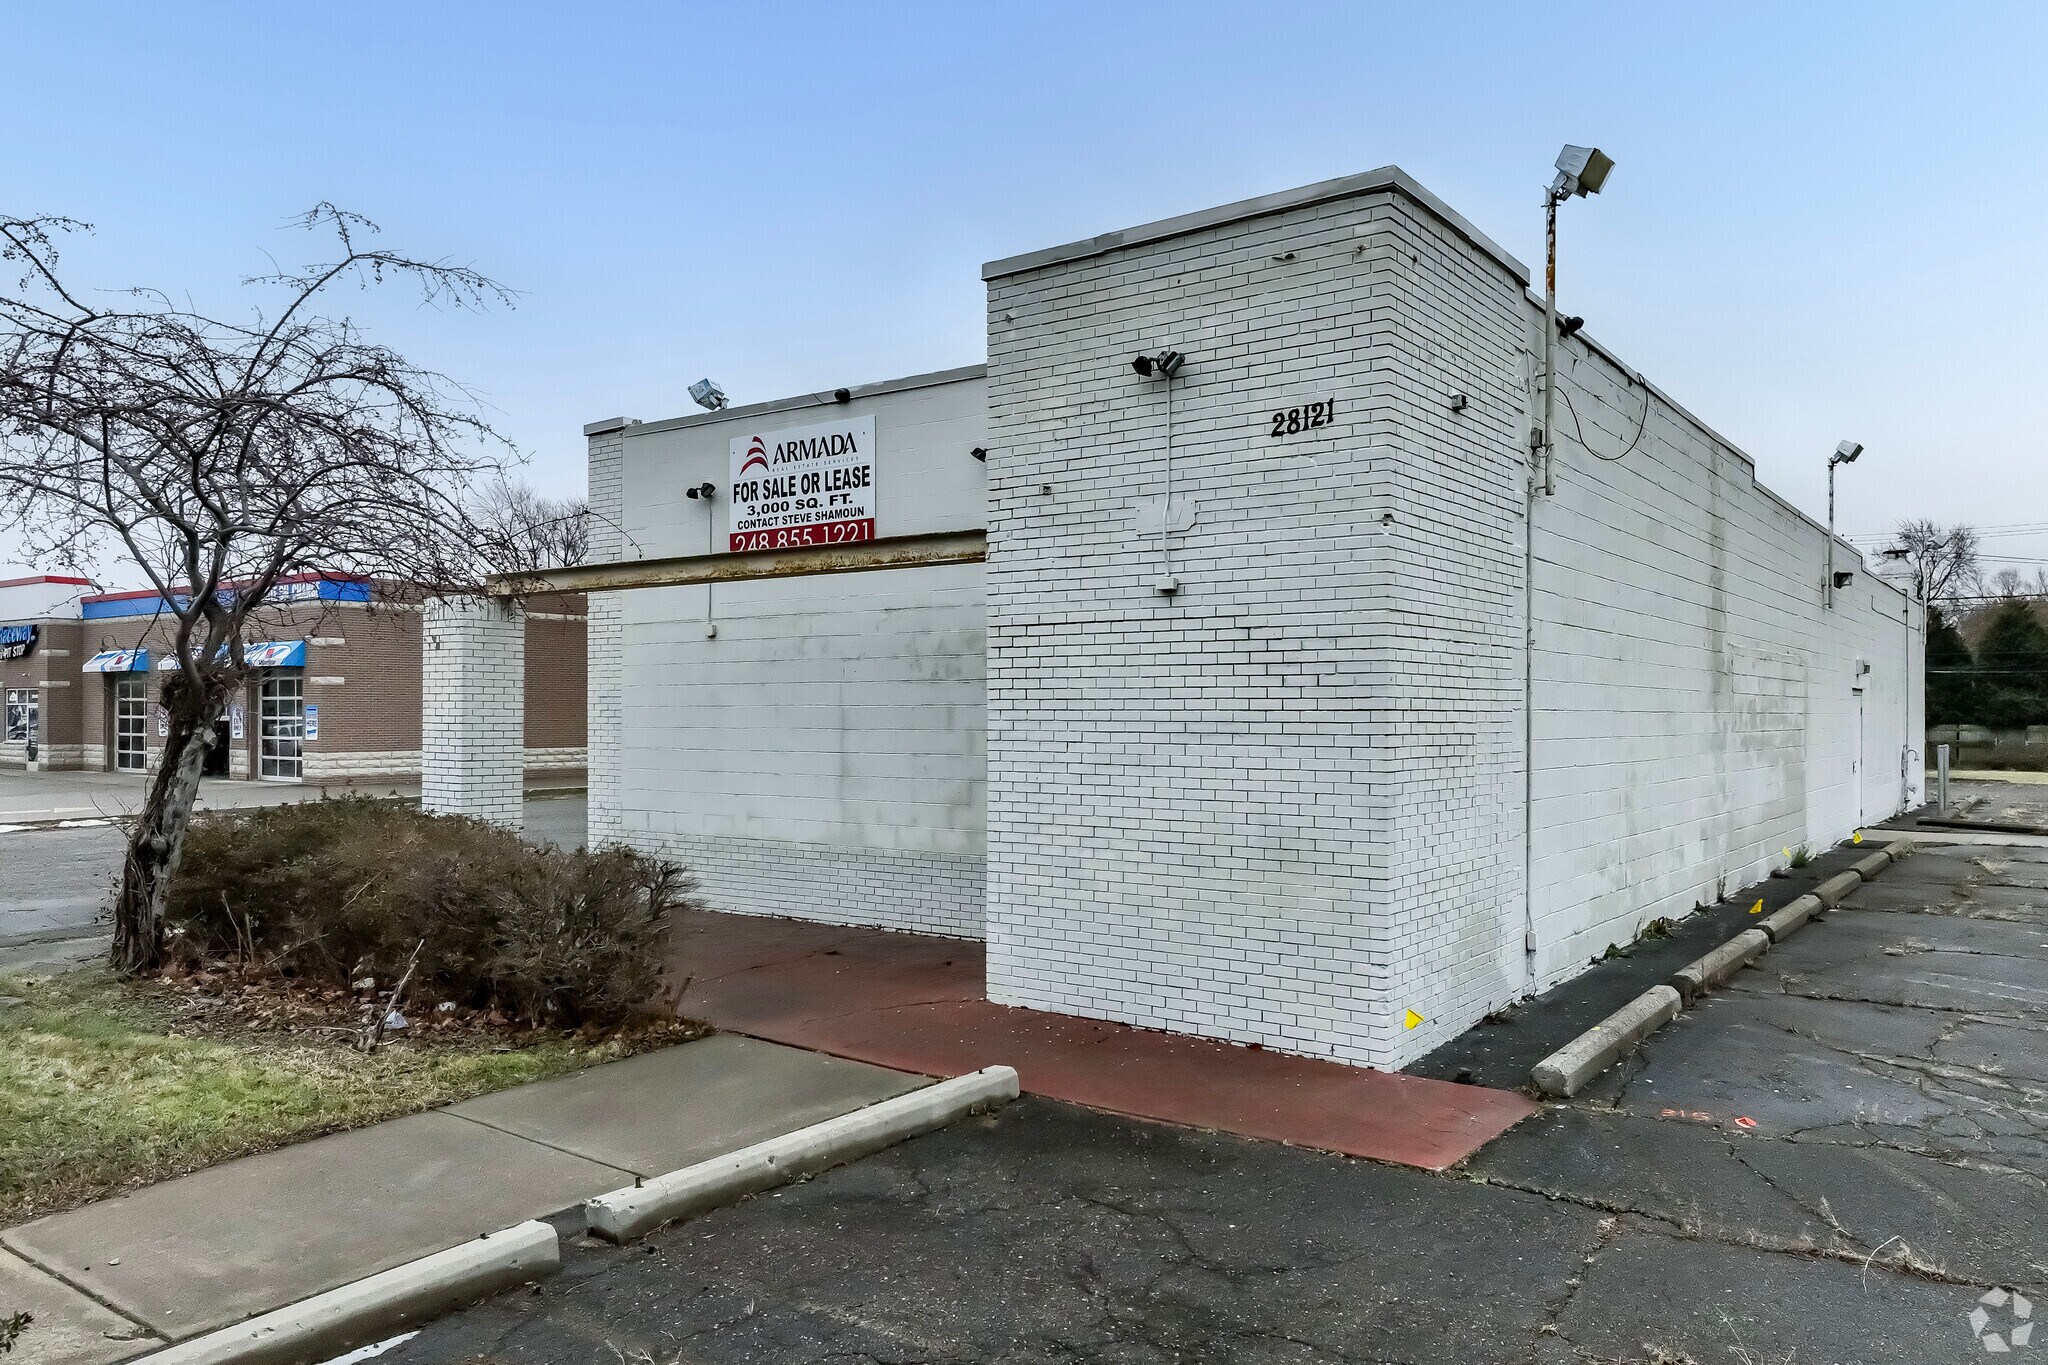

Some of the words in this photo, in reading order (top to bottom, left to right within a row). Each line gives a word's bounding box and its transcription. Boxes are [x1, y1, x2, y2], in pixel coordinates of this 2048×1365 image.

[1271, 397, 1334, 438] 28121
[773, 432, 857, 465] ARMADA
[733, 481, 759, 504] FOR
[763, 475, 797, 500] SALE
[801, 472, 821, 495] OR
[825, 465, 871, 492] LEASE
[737, 516, 779, 530] CONTACT
[782, 513, 812, 525] STEVE
[815, 507, 864, 521] SHAMOUN
[747, 501, 790, 517] 3,000
[795, 497, 824, 510] SQ.
[829, 493, 854, 506] FT.
[735, 532, 769, 551] 248
[823, 522, 869, 543] 1221
